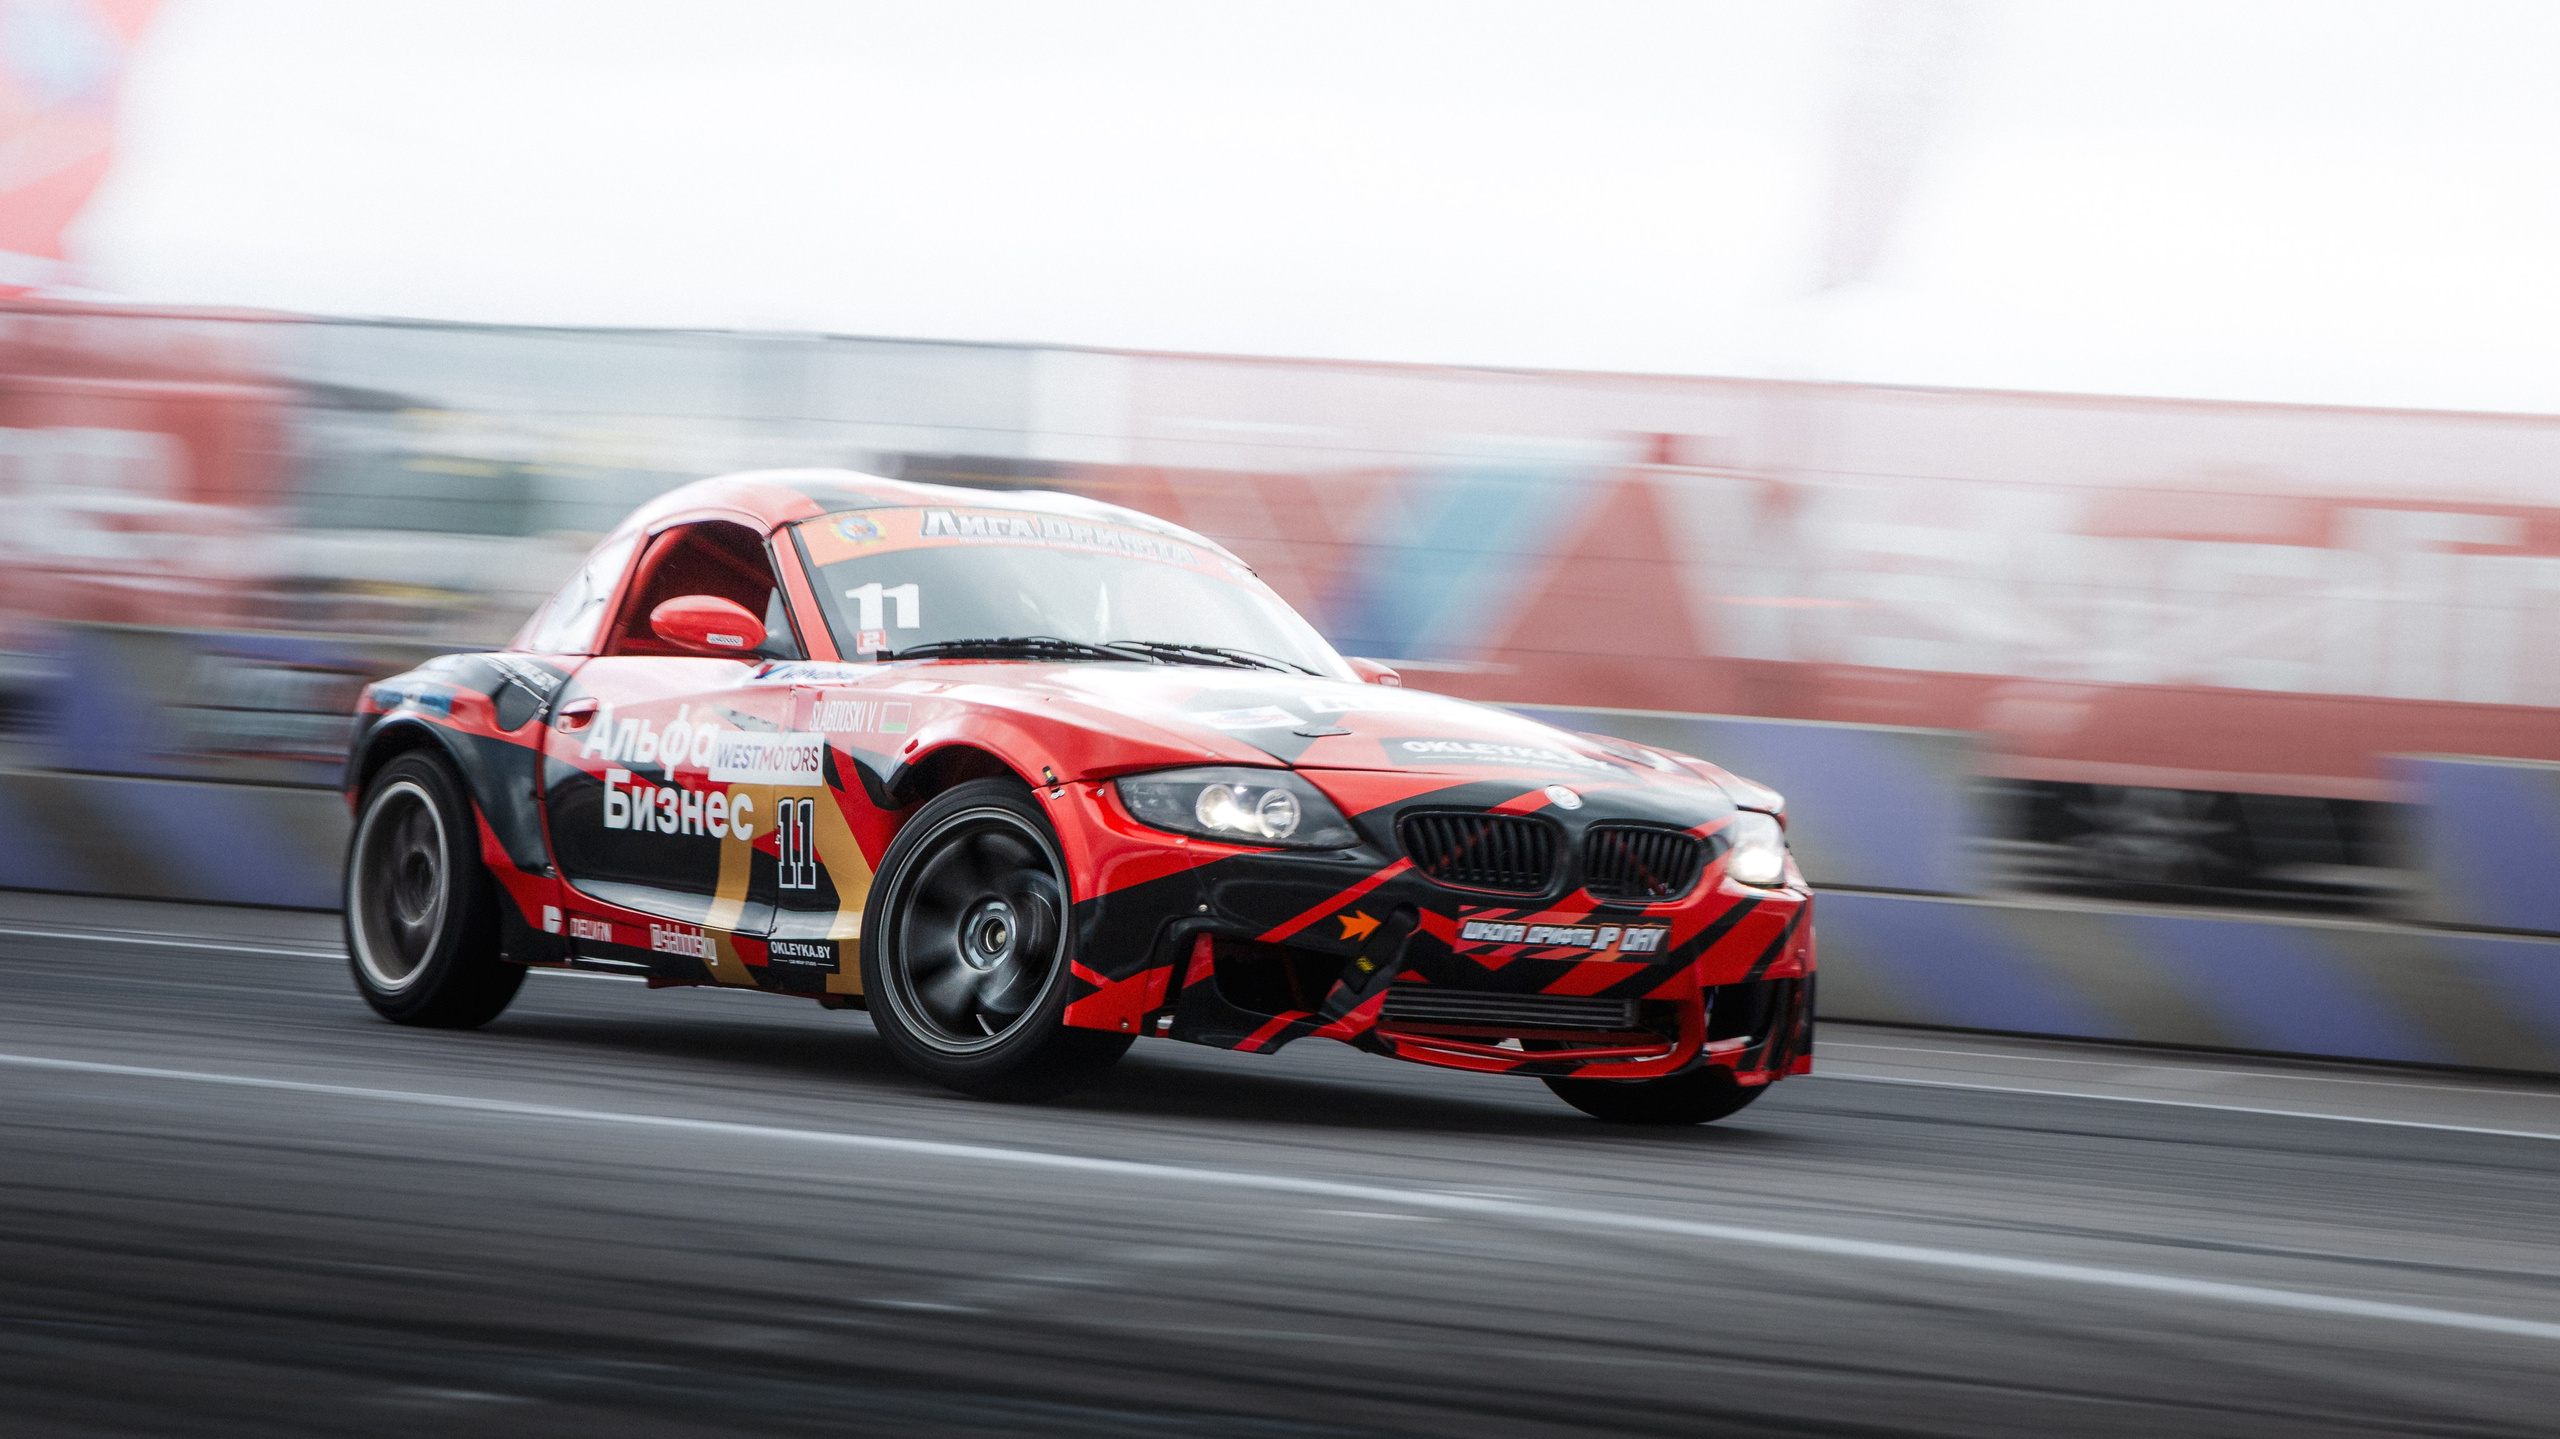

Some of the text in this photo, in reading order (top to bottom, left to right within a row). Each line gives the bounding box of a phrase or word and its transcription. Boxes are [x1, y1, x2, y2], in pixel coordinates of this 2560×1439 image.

[845, 582, 921, 630] 11
[580, 703, 722, 782] Альфа
[717, 742, 819, 773] WESTMOTORS
[604, 768, 754, 841] Бизнес
[776, 797, 816, 890] 11
[649, 923, 719, 966] @slabodsky
[770, 940, 831, 959] OKLEYKA.BY
[1590, 926, 1621, 950] JP
[1618, 927, 1667, 951] DAY
